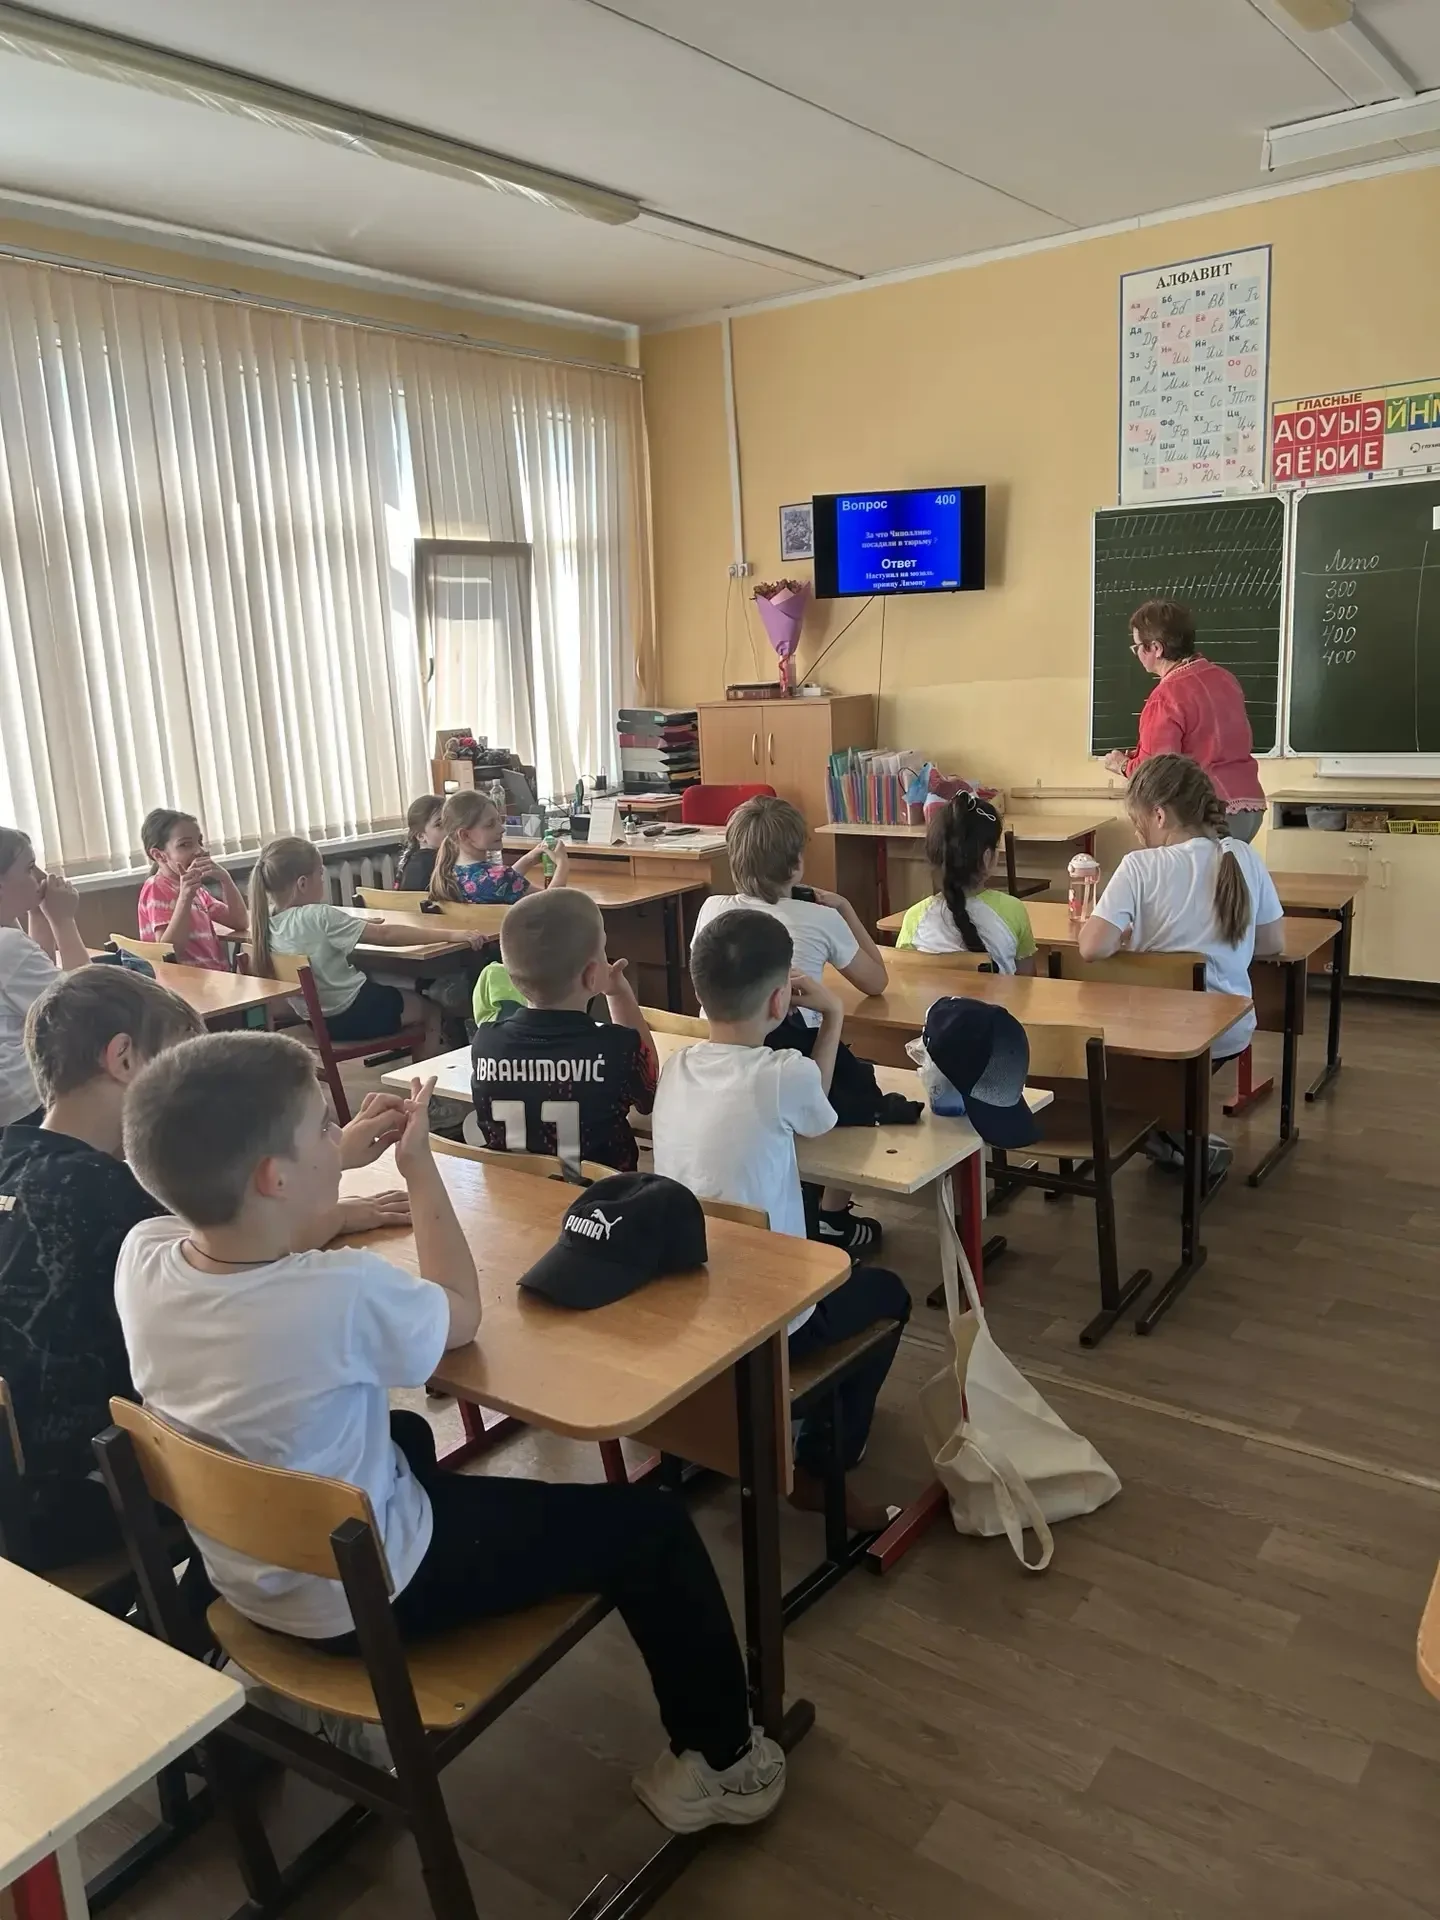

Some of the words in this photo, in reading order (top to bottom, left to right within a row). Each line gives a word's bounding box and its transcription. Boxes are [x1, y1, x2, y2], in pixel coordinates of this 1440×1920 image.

[1156, 262, 1232, 289] АЛФАВИТ
[1296, 393, 1362, 411] ГЛАСНЫЕ
[842, 500, 888, 512] Вопрос
[935, 494, 956, 505] 400
[890, 529, 932, 537] Чиполлино
[904, 539, 932, 547] тюрьму
[881, 559, 917, 569] Ответ
[1325, 548, 1380, 572] Лето
[873, 581, 898, 589] принцу
[1325, 580, 1357, 600] 300
[1322, 603, 1358, 621] 300
[1322, 626, 1357, 646] 400
[1322, 650, 1356, 666] 400
[476, 1054, 605, 1082] IBRAHIMOVIĆ
[491, 1100, 581, 1182] 11
[565, 1215, 605, 1240] PUMA
